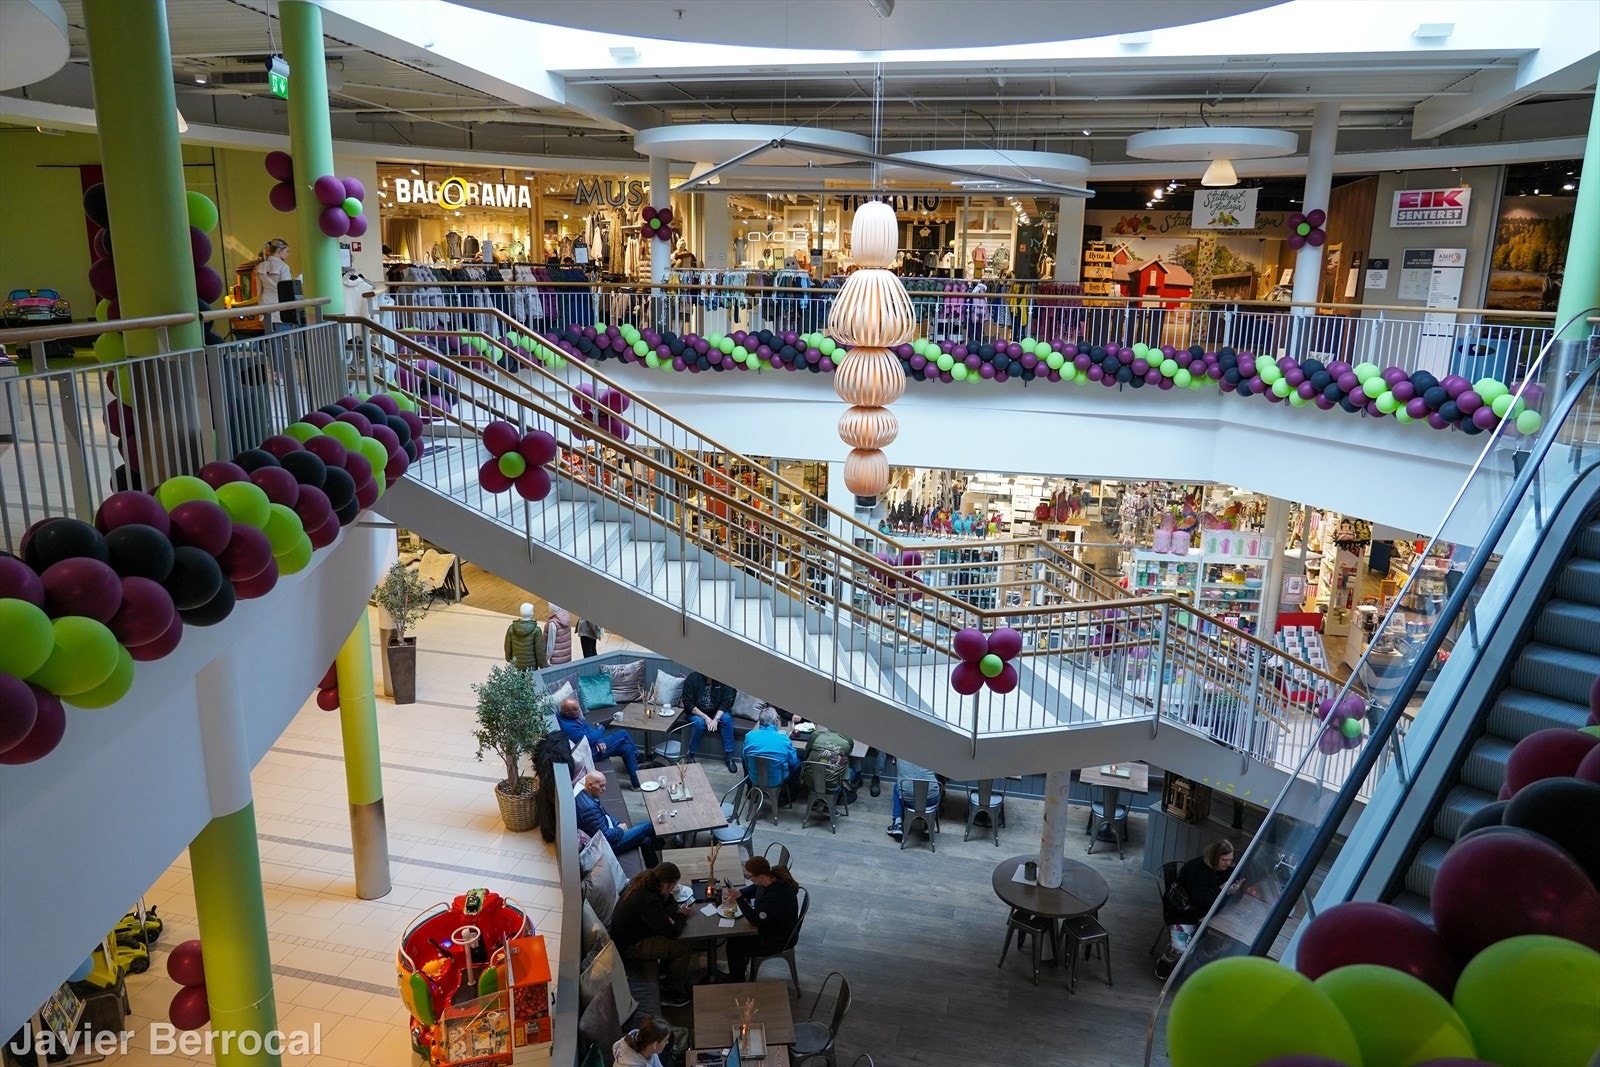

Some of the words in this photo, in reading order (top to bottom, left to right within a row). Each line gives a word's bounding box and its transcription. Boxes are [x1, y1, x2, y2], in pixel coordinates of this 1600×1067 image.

[395, 177, 532, 209] BAGORAMA
[1399, 190, 1464, 208] EIK
[1399, 209, 1461, 220] SENTERET
